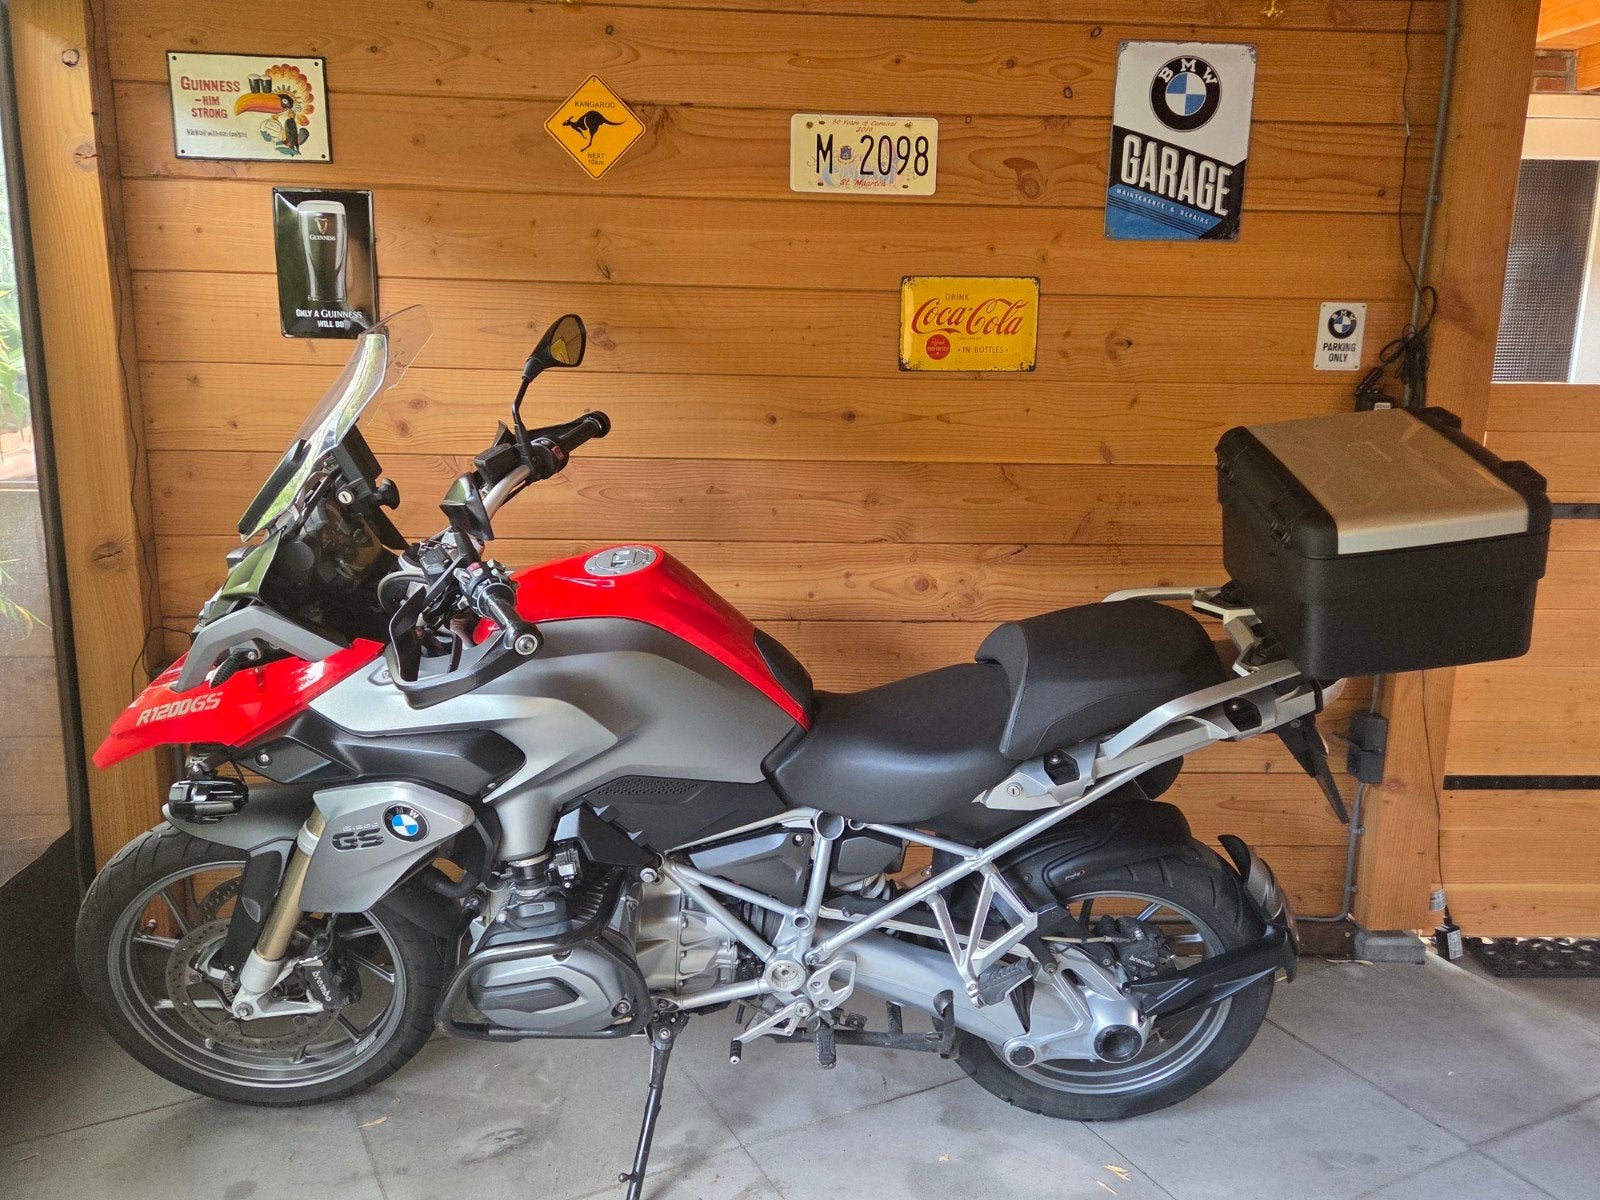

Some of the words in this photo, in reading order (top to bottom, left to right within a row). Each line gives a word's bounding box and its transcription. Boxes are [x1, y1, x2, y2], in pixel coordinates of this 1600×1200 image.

[1158, 58, 1217, 84] BMW
[180, 76, 241, 93] GUINNESS
[574, 101, 616, 109] KANGAROO
[191, 108, 228, 119] STRONG
[816, 133, 833, 174] M
[860, 134, 929, 176] 2098
[1120, 134, 1234, 217] GARAGE
[1116, 188, 1165, 210] MAINTENANCE
[1180, 210, 1209, 225] REPAIRS
[945, 293, 970, 301] DRINK
[295, 308, 312, 318] ONLY
[314, 310, 320, 318] A
[321, 309, 363, 319] GUINNESS
[317, 319, 334, 329] WILL
[962, 346, 971, 354] IN
[974, 346, 1004, 355] BOTTLES
[1322, 342, 1357, 352] PARKING
[1328, 353, 1348, 362] ONLY
[135, 691, 224, 727] R1200GS
[331, 827, 385, 851] GS
[1129, 954, 1156, 968] brembo
[312, 970, 332, 1002] brembo
